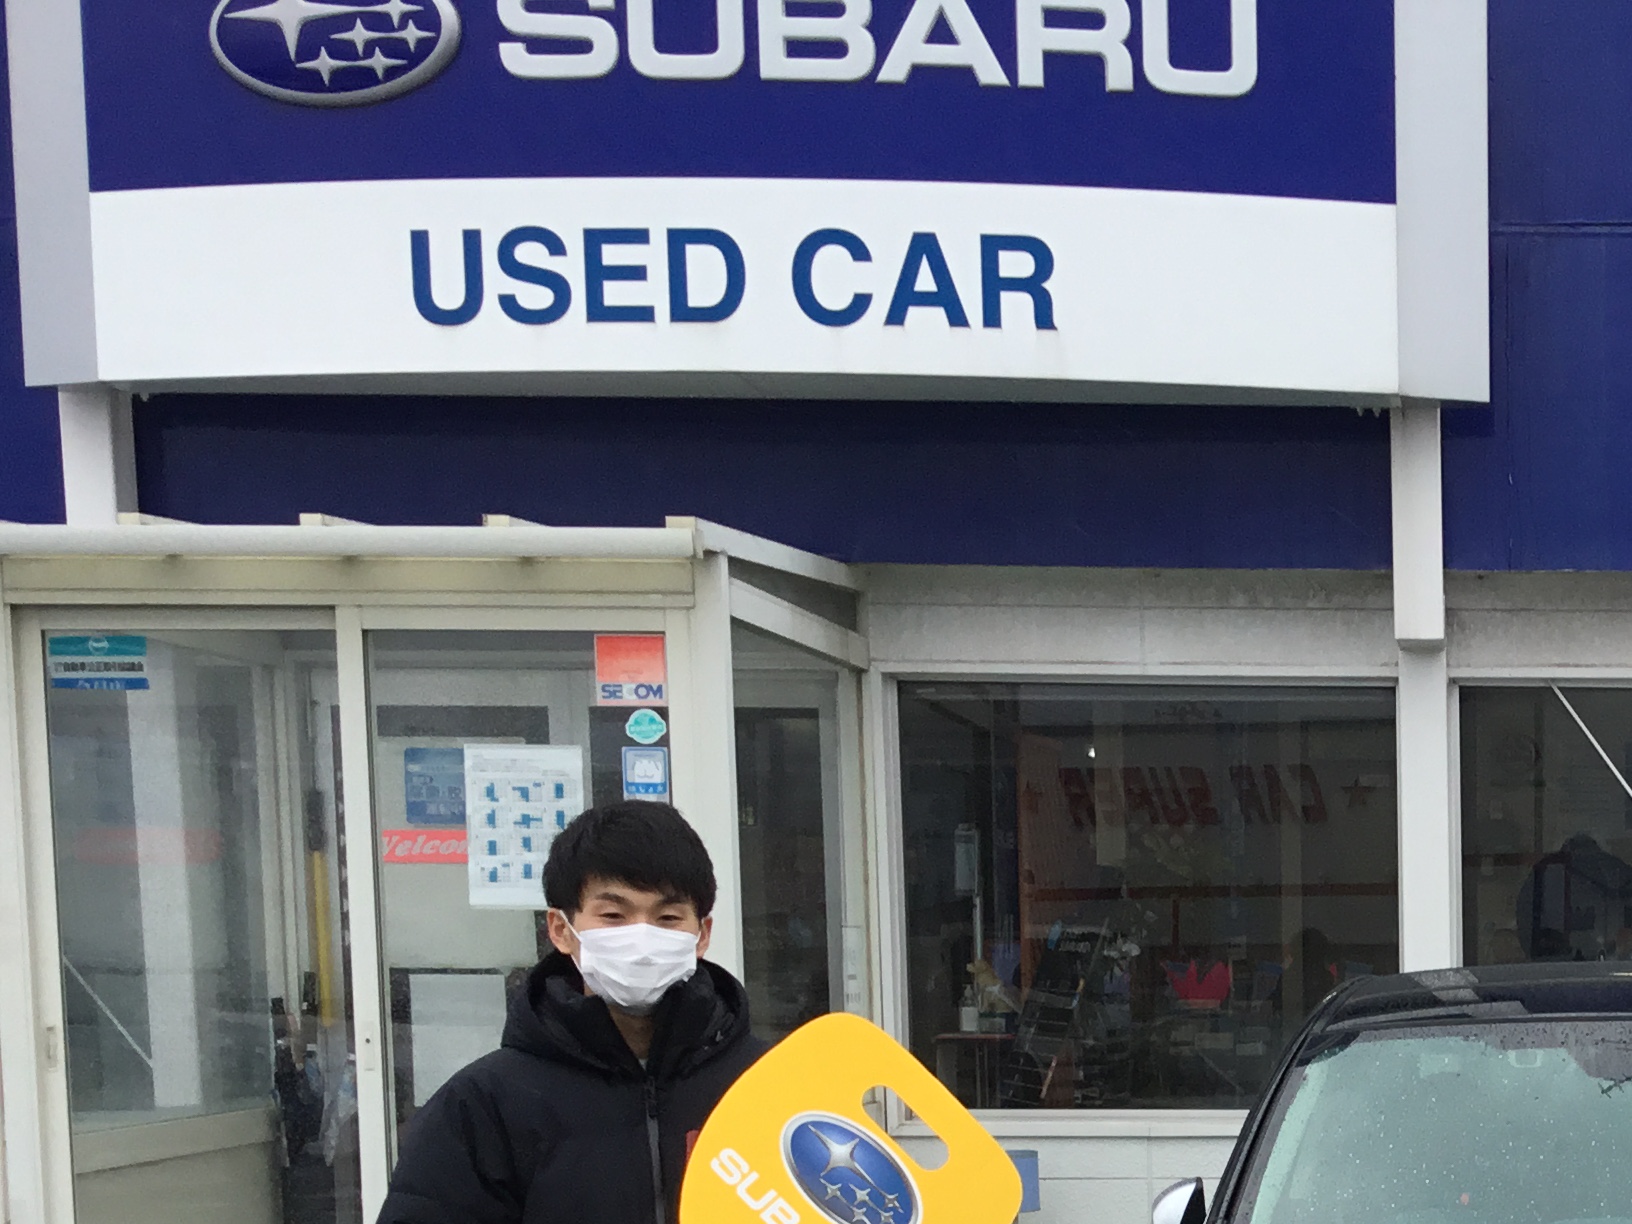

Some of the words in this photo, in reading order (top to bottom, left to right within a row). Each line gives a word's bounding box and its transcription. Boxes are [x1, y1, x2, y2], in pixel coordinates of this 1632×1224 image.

[496, 0, 1258, 97] SUBARU
[410, 225, 746, 326] USED
[791, 228, 1058, 331] CAR
